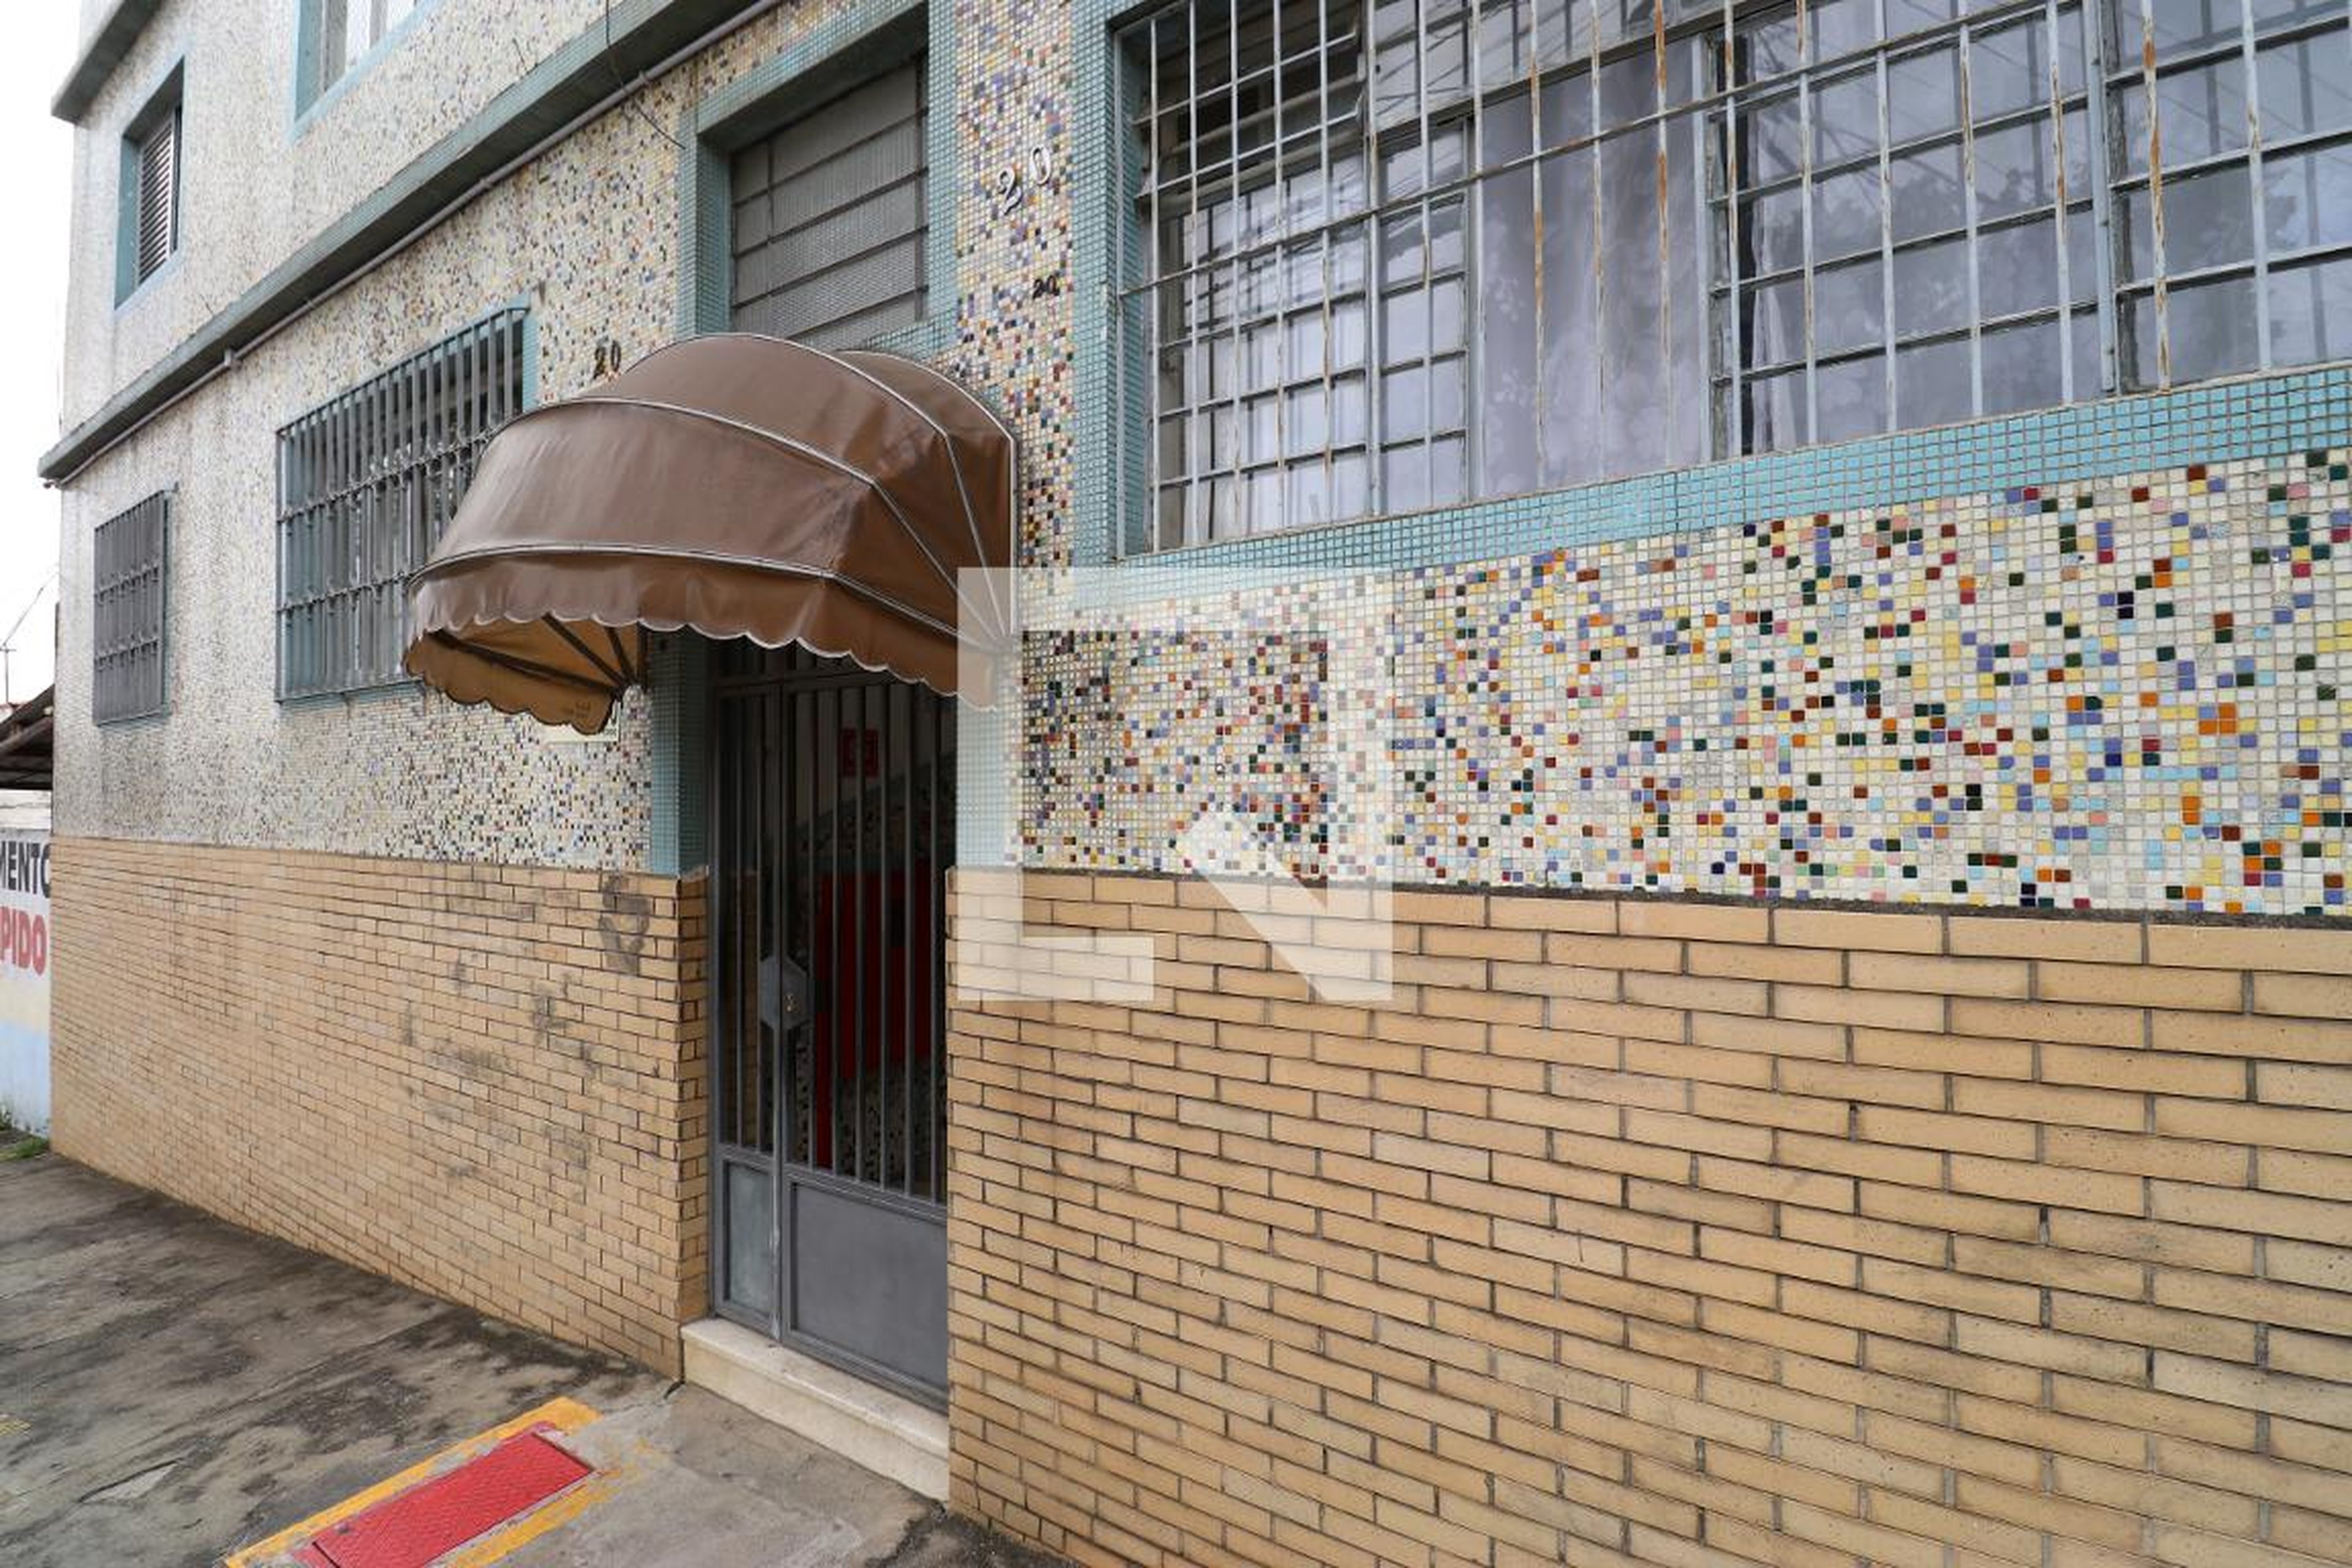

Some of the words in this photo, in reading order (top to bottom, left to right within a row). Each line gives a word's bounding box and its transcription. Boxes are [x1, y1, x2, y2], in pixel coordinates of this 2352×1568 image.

[997, 145, 1051, 215] 20
[1033, 275, 1057, 300] 20
[594, 339, 621, 380] 20
